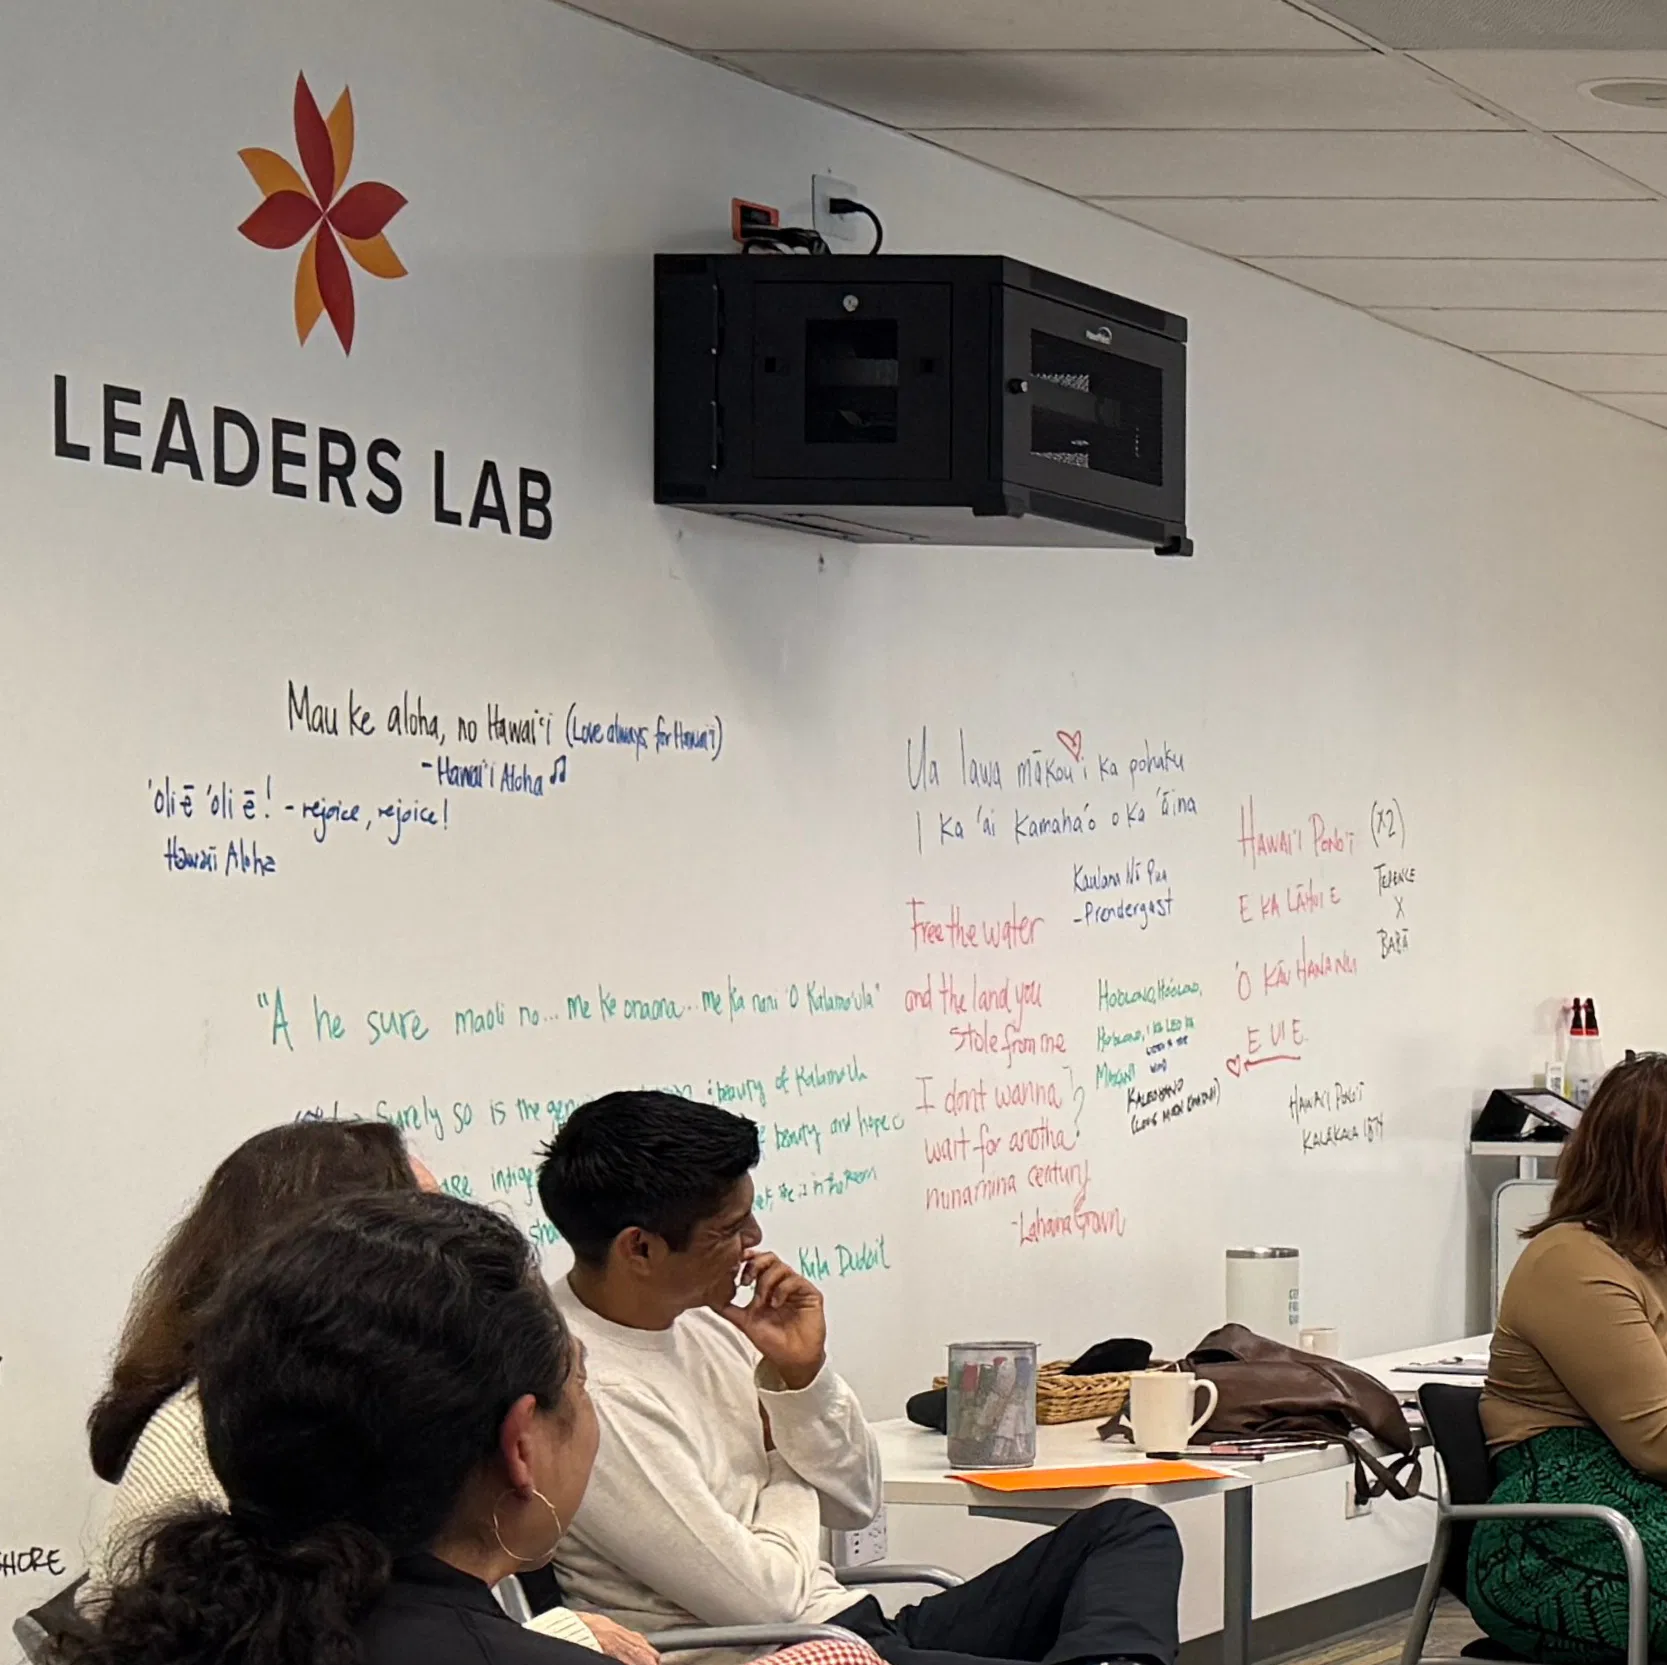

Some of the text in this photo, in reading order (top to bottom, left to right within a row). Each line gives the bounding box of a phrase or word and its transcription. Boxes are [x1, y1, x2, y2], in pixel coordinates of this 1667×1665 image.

[53, 374, 555, 541] LEADERS LAB
[288, 679, 339, 737] Mau
[349, 689, 376, 736] ke
[458, 715, 479, 743] no
[906, 725, 939, 791] Ua
[959, 727, 1003, 790] lawa
[904, 972, 933, 1013] and
[938, 971, 968, 1015] the
[972, 972, 1013, 1013] land
[313, 994, 346, 1041] he
[367, 1008, 429, 1046] sure
[453, 1100, 473, 1134] so
[490, 1098, 506, 1126] is
[0, 1546, 67, 1577] HORE
